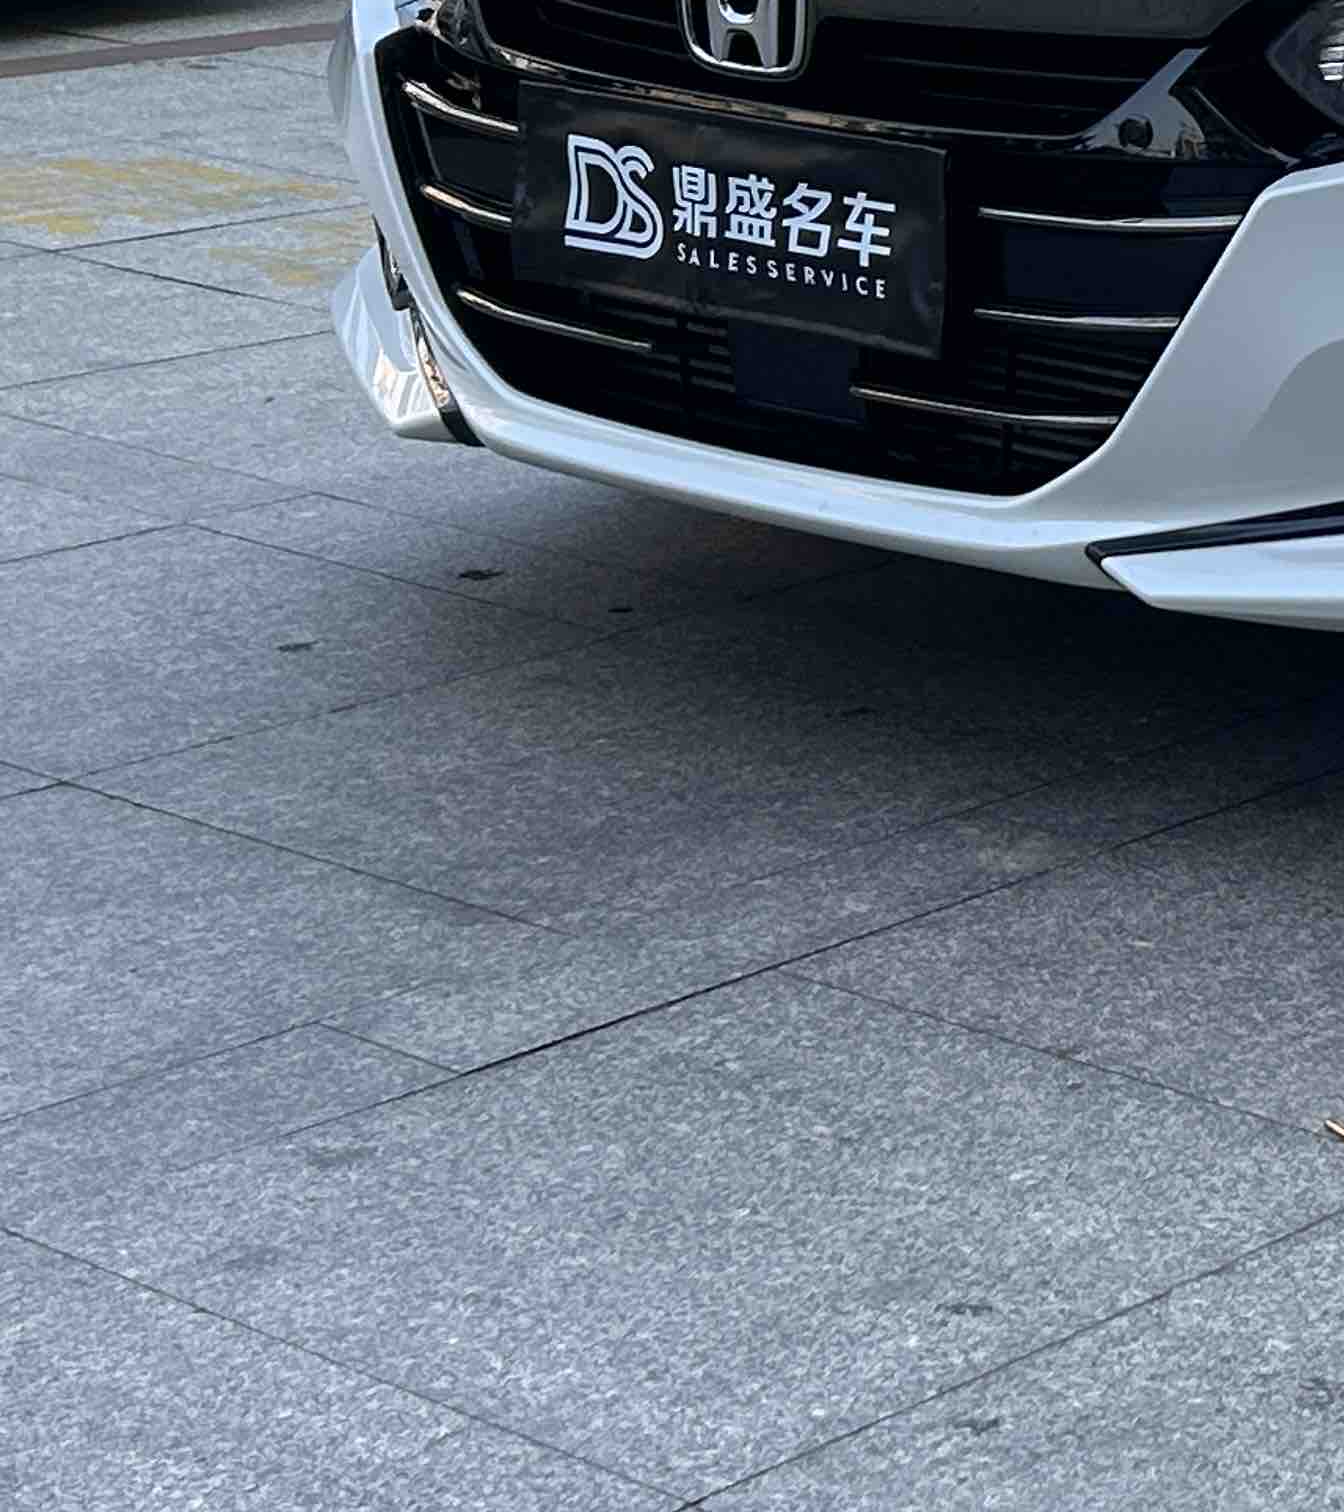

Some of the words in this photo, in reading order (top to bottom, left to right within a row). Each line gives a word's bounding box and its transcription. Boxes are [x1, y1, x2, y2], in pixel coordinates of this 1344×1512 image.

[563, 133, 664, 260] DS
[672, 164, 897, 268] 鼎盛名车
